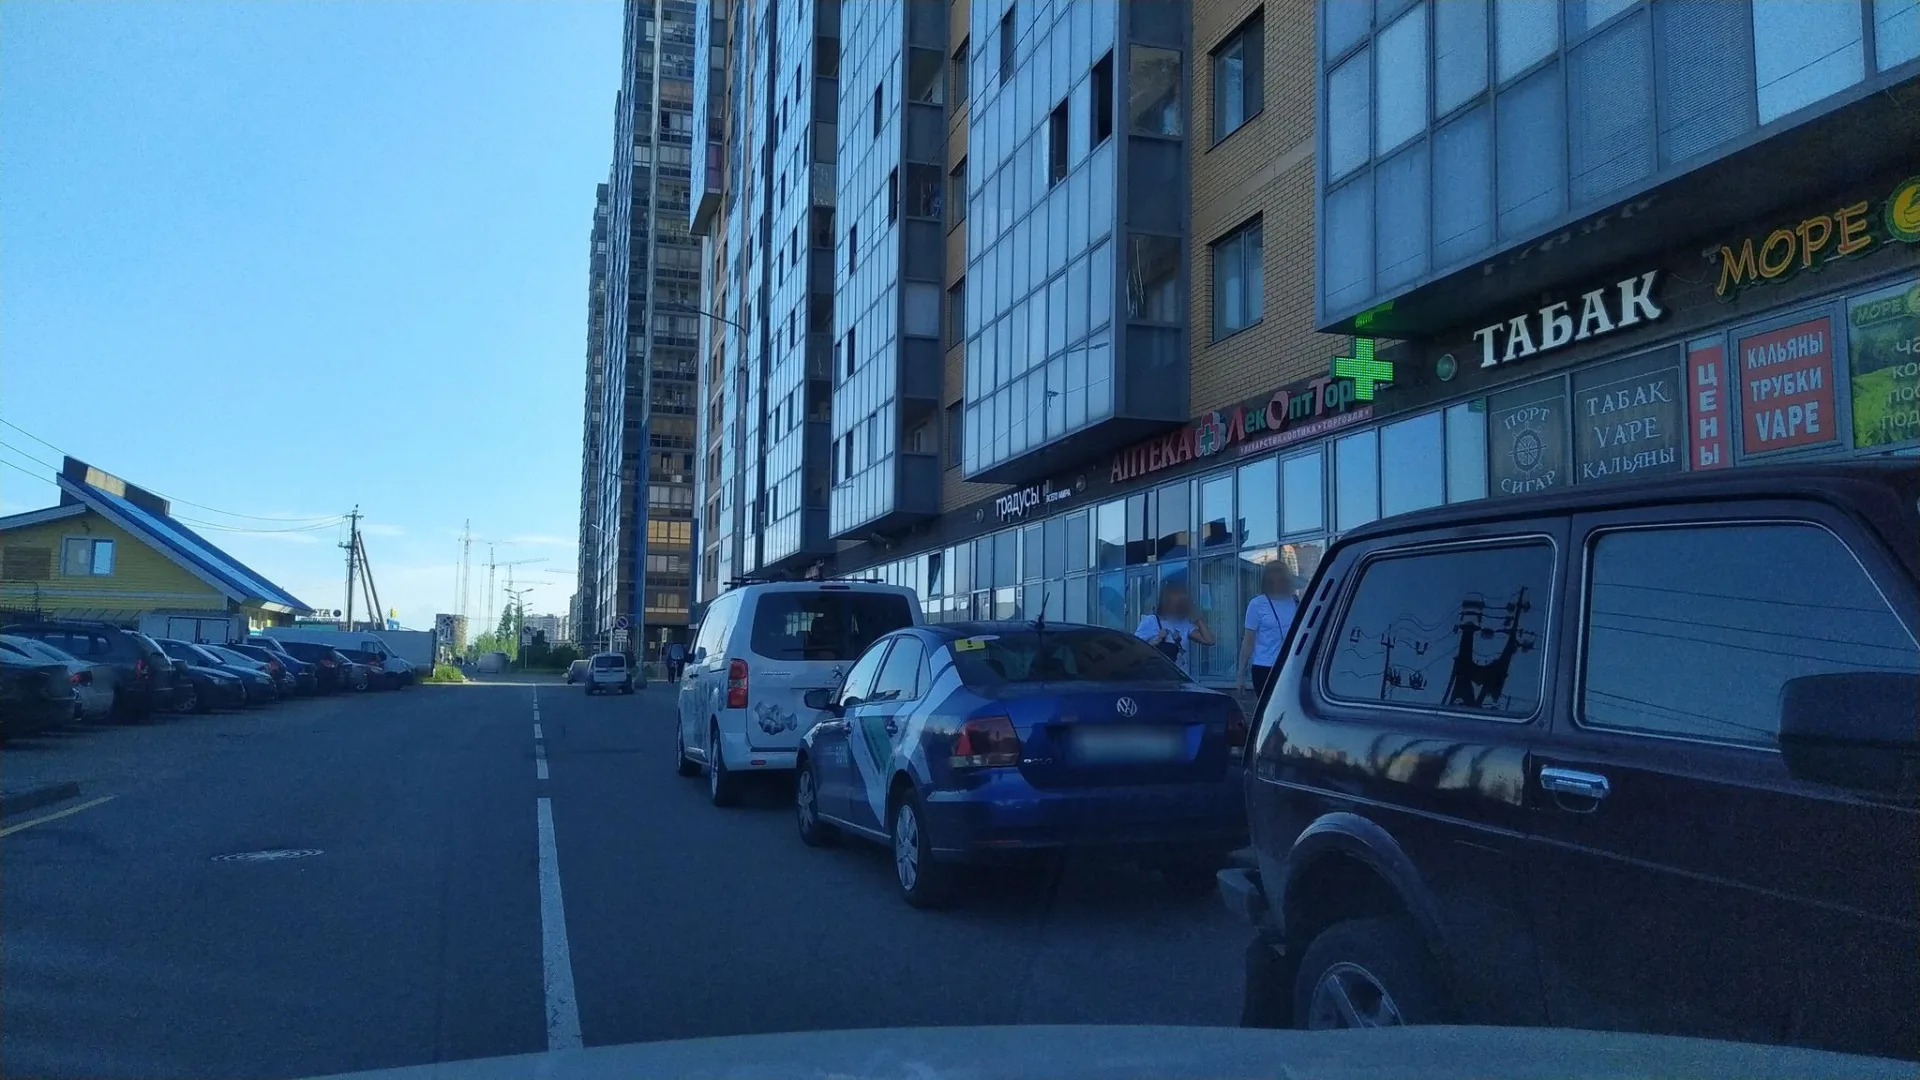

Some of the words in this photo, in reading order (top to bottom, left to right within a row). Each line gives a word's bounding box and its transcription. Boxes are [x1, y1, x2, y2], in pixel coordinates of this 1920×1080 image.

[1716, 201, 1872, 296] МОРЕ
[1473, 270, 1662, 369] ТАБАК
[1855, 299, 1901, 324] МОРЕ
[1747, 331, 1824, 369] КАЛЬЯНЫ
[1586, 381, 1672, 417] ТАБАК
[1750, 367, 1822, 402] ТРУБКИ
[1504, 407, 1551, 430] ПОРТ
[1697, 362, 1720, 466] ЦЕНЫ
[1755, 401, 1820, 441] VAPE
[1594, 417, 1661, 449] VAPE
[1109, 426, 1193, 484] АПТЕКА
[1583, 448, 1676, 478] КАЛЬЯНЫ
[1501, 471, 1556, 494] СИГАР
[996, 485, 1040, 522] градусы
